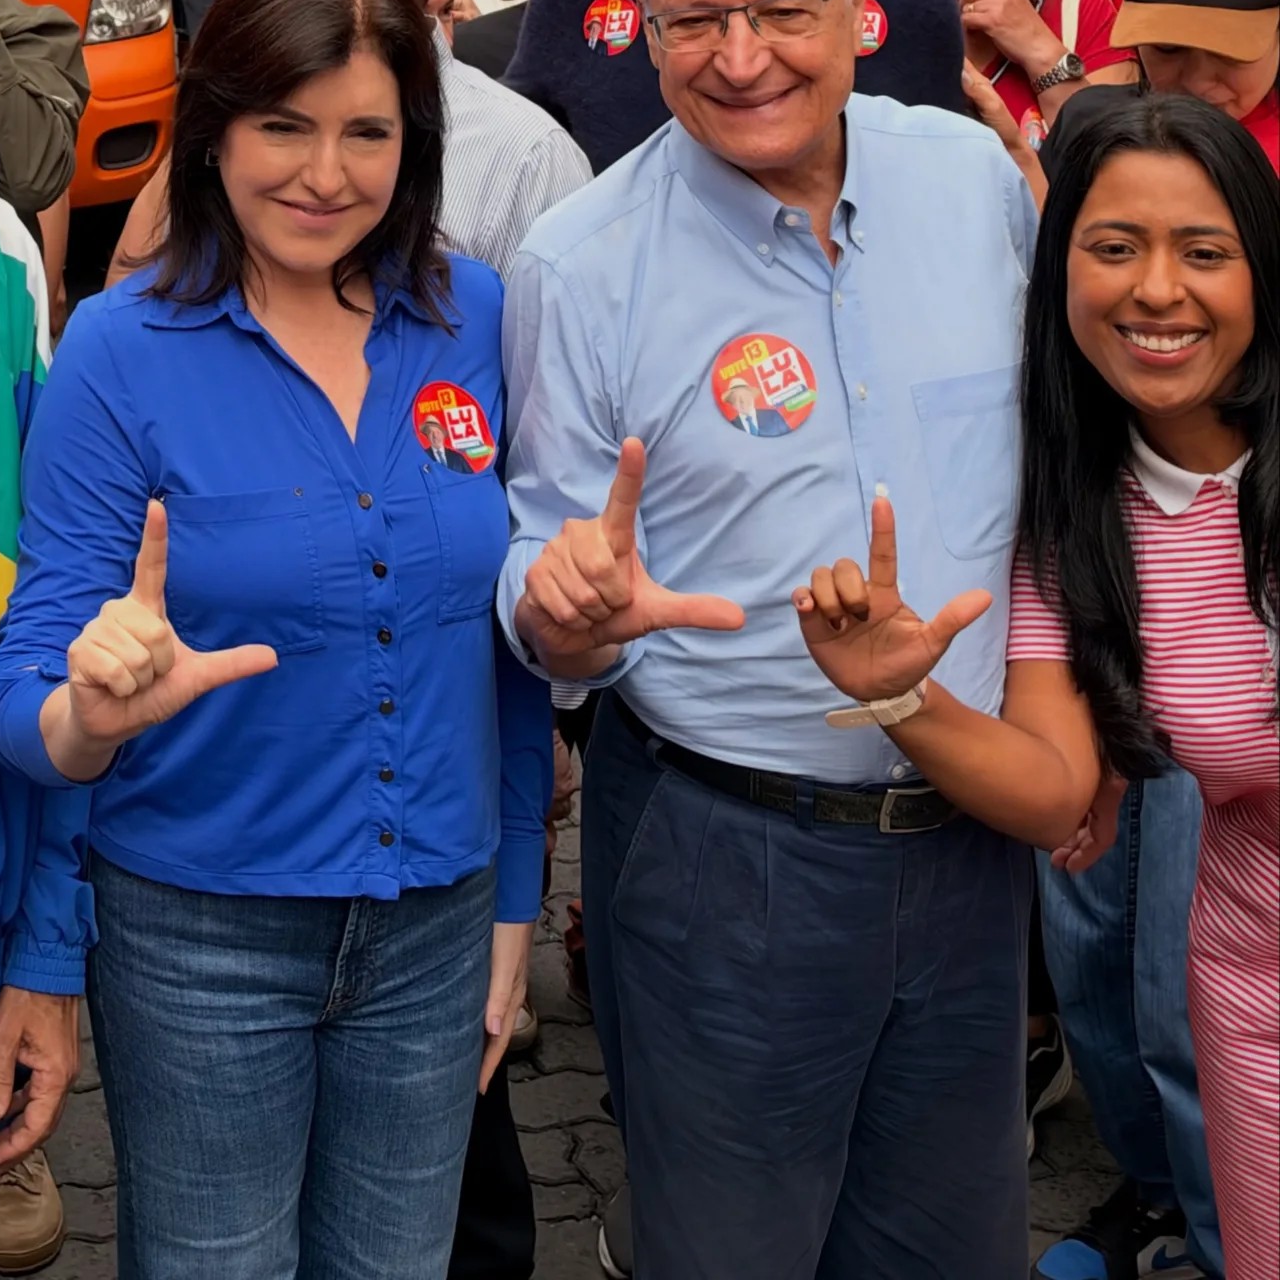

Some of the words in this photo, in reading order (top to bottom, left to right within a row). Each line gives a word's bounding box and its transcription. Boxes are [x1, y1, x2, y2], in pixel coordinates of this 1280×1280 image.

[757, 352, 792, 382] LU
[762, 368, 801, 397] LA
[446, 408, 473, 426] LU
[450, 423, 478, 441] LA
